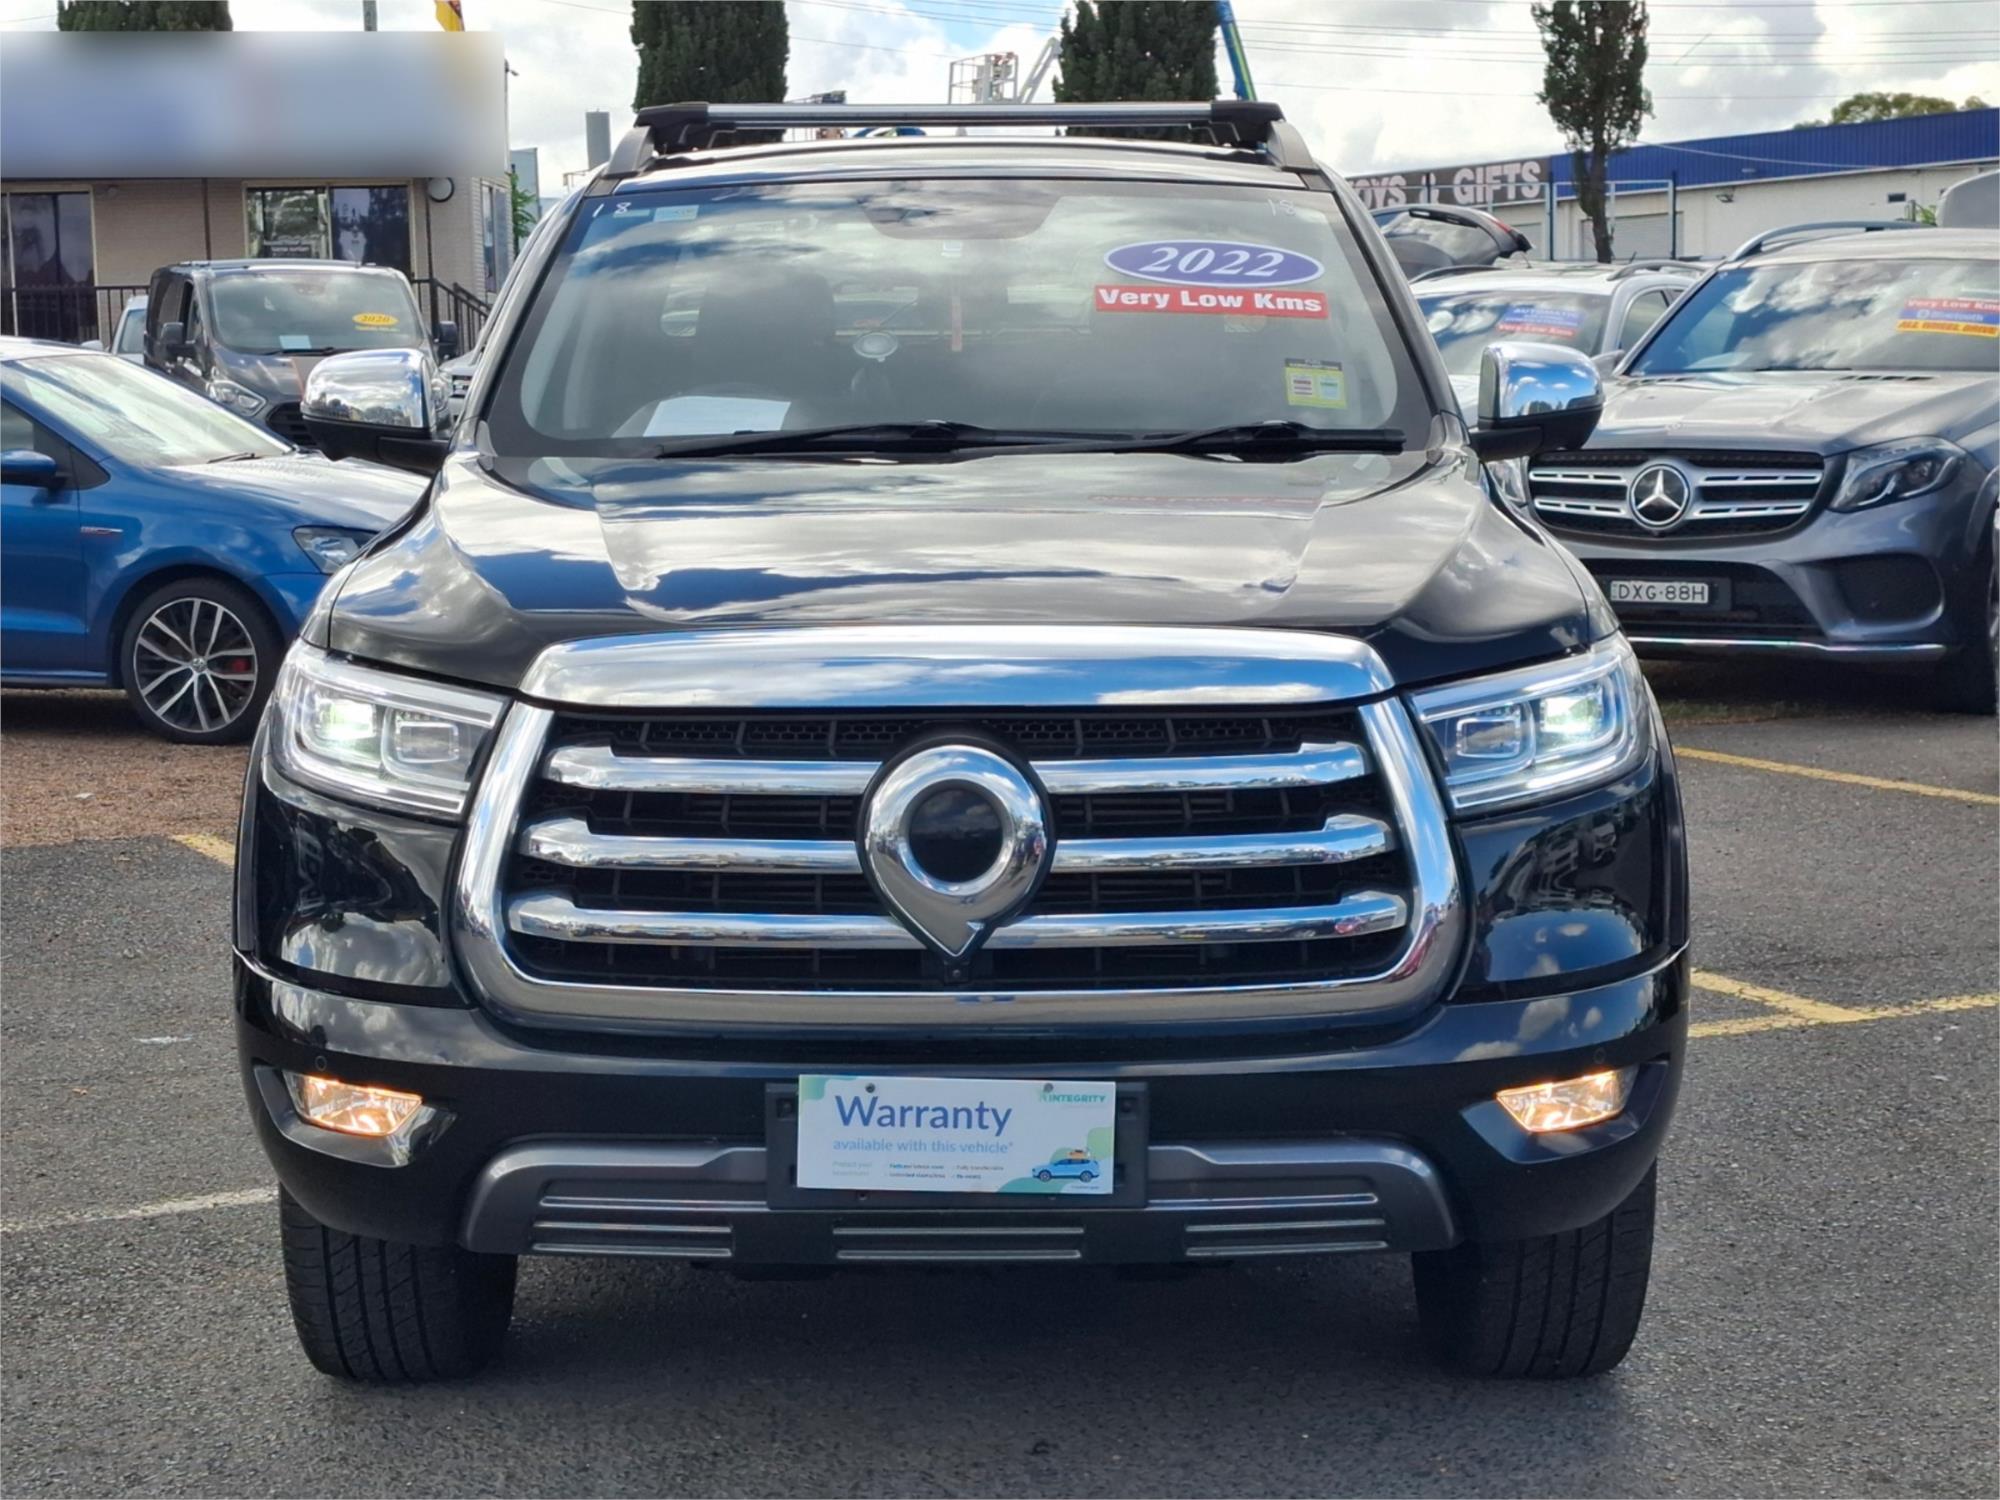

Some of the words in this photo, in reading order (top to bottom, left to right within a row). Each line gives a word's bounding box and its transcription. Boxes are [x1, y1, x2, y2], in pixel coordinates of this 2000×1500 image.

[1348, 176, 1407, 209] OYS
[1453, 161, 1541, 205] GIFTS
[1138, 247, 1284, 277] 2022
[1099, 288, 1170, 309] Very
[1180, 290, 1243, 308] Low
[1254, 293, 1322, 312] Kms
[1908, 300, 1938, 309] Very
[1942, 300, 1971, 309] Low
[362, 315, 390, 323] 2020
[1048, 1093, 1106, 1103] INTEGRITY
[835, 1095, 1012, 1137] Warranty
[833, 1138, 893, 1151] available
[897, 1139, 928, 1152] with
[931, 1140, 956, 1153] this
